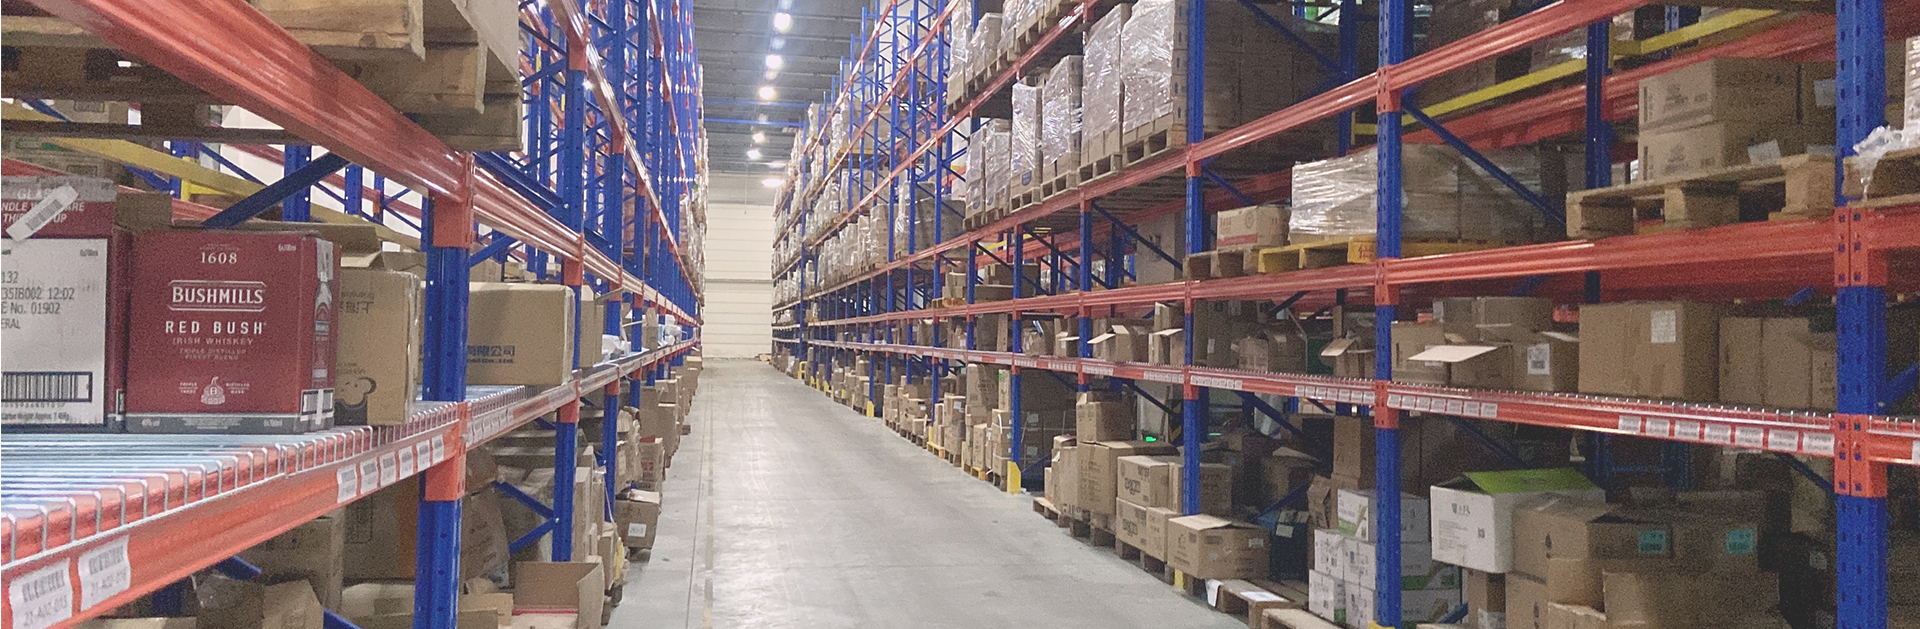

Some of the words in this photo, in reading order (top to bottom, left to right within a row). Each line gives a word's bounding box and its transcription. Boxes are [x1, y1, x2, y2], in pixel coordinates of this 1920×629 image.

[53, 214, 68, 223] UP
[201, 252, 238, 264] 1608
[48, 287, 75, 300] 12:02
[172, 286, 264, 304] BUSHMILLS
[11, 302, 26, 315] No.
[165, 320, 200, 334] RED
[213, 321, 263, 335] BUSH
[172, 337, 201, 345] IRISH
[205, 337, 254, 346] WHISKEY
